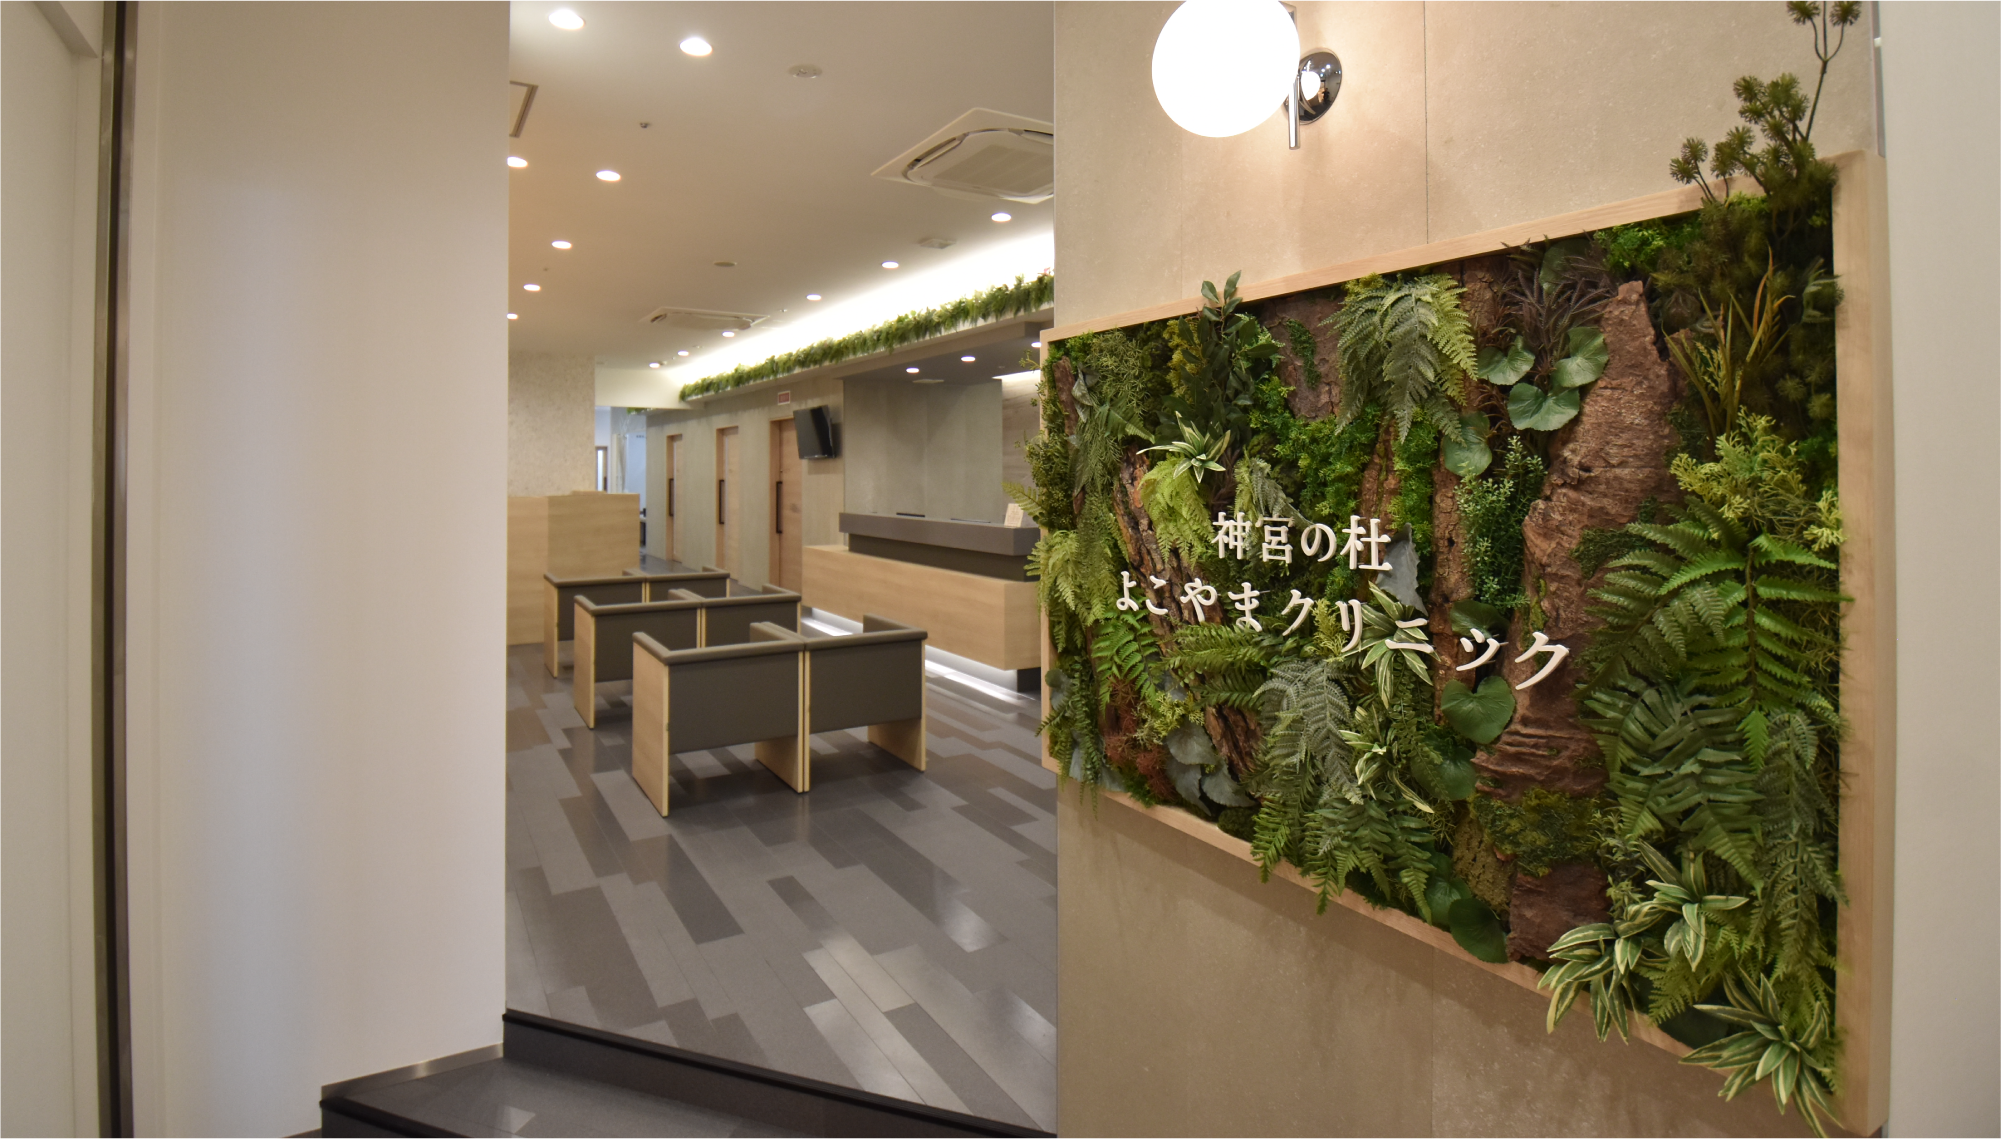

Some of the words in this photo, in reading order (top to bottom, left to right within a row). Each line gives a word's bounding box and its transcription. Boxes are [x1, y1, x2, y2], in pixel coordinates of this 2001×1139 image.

[1212, 512, 1392, 571] 神宮の杜
[1115, 570, 1570, 690] よこやまクリニック
